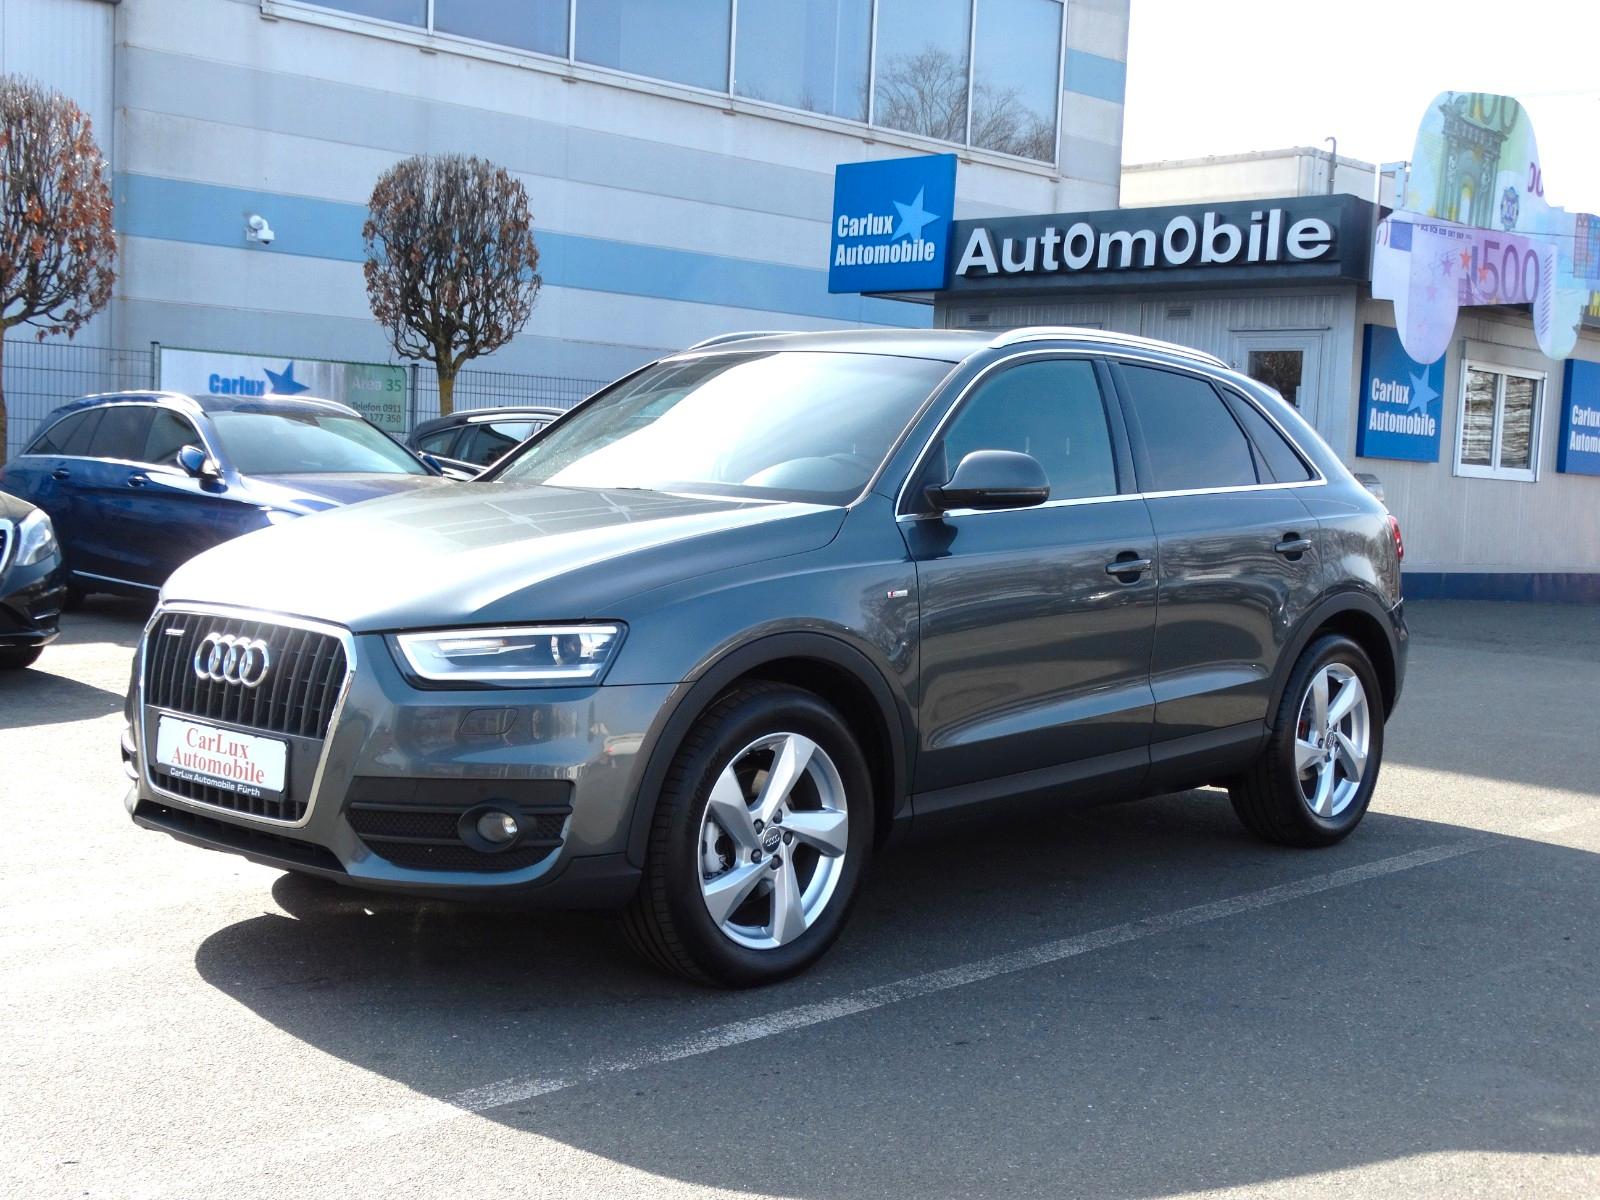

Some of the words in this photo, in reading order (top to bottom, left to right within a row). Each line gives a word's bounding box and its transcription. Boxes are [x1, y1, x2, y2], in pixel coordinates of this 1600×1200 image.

[837, 213, 894, 238] Carlux
[834, 239, 936, 267] Automobile
[1483, 239, 1540, 303] 500
[209, 373, 265, 396] Carlux
[386, 379, 402, 392] 35
[1371, 377, 1410, 405] Carlux
[352, 402, 381, 412] Telefon
[1369, 408, 1436, 437] Automobile
[186, 727, 249, 760] CarLux
[171, 746, 265, 784] Automobile
[170, 767, 193, 780] CarLux
[193, 775, 235, 791] Automobile
[236, 784, 261, 797] Fürth
